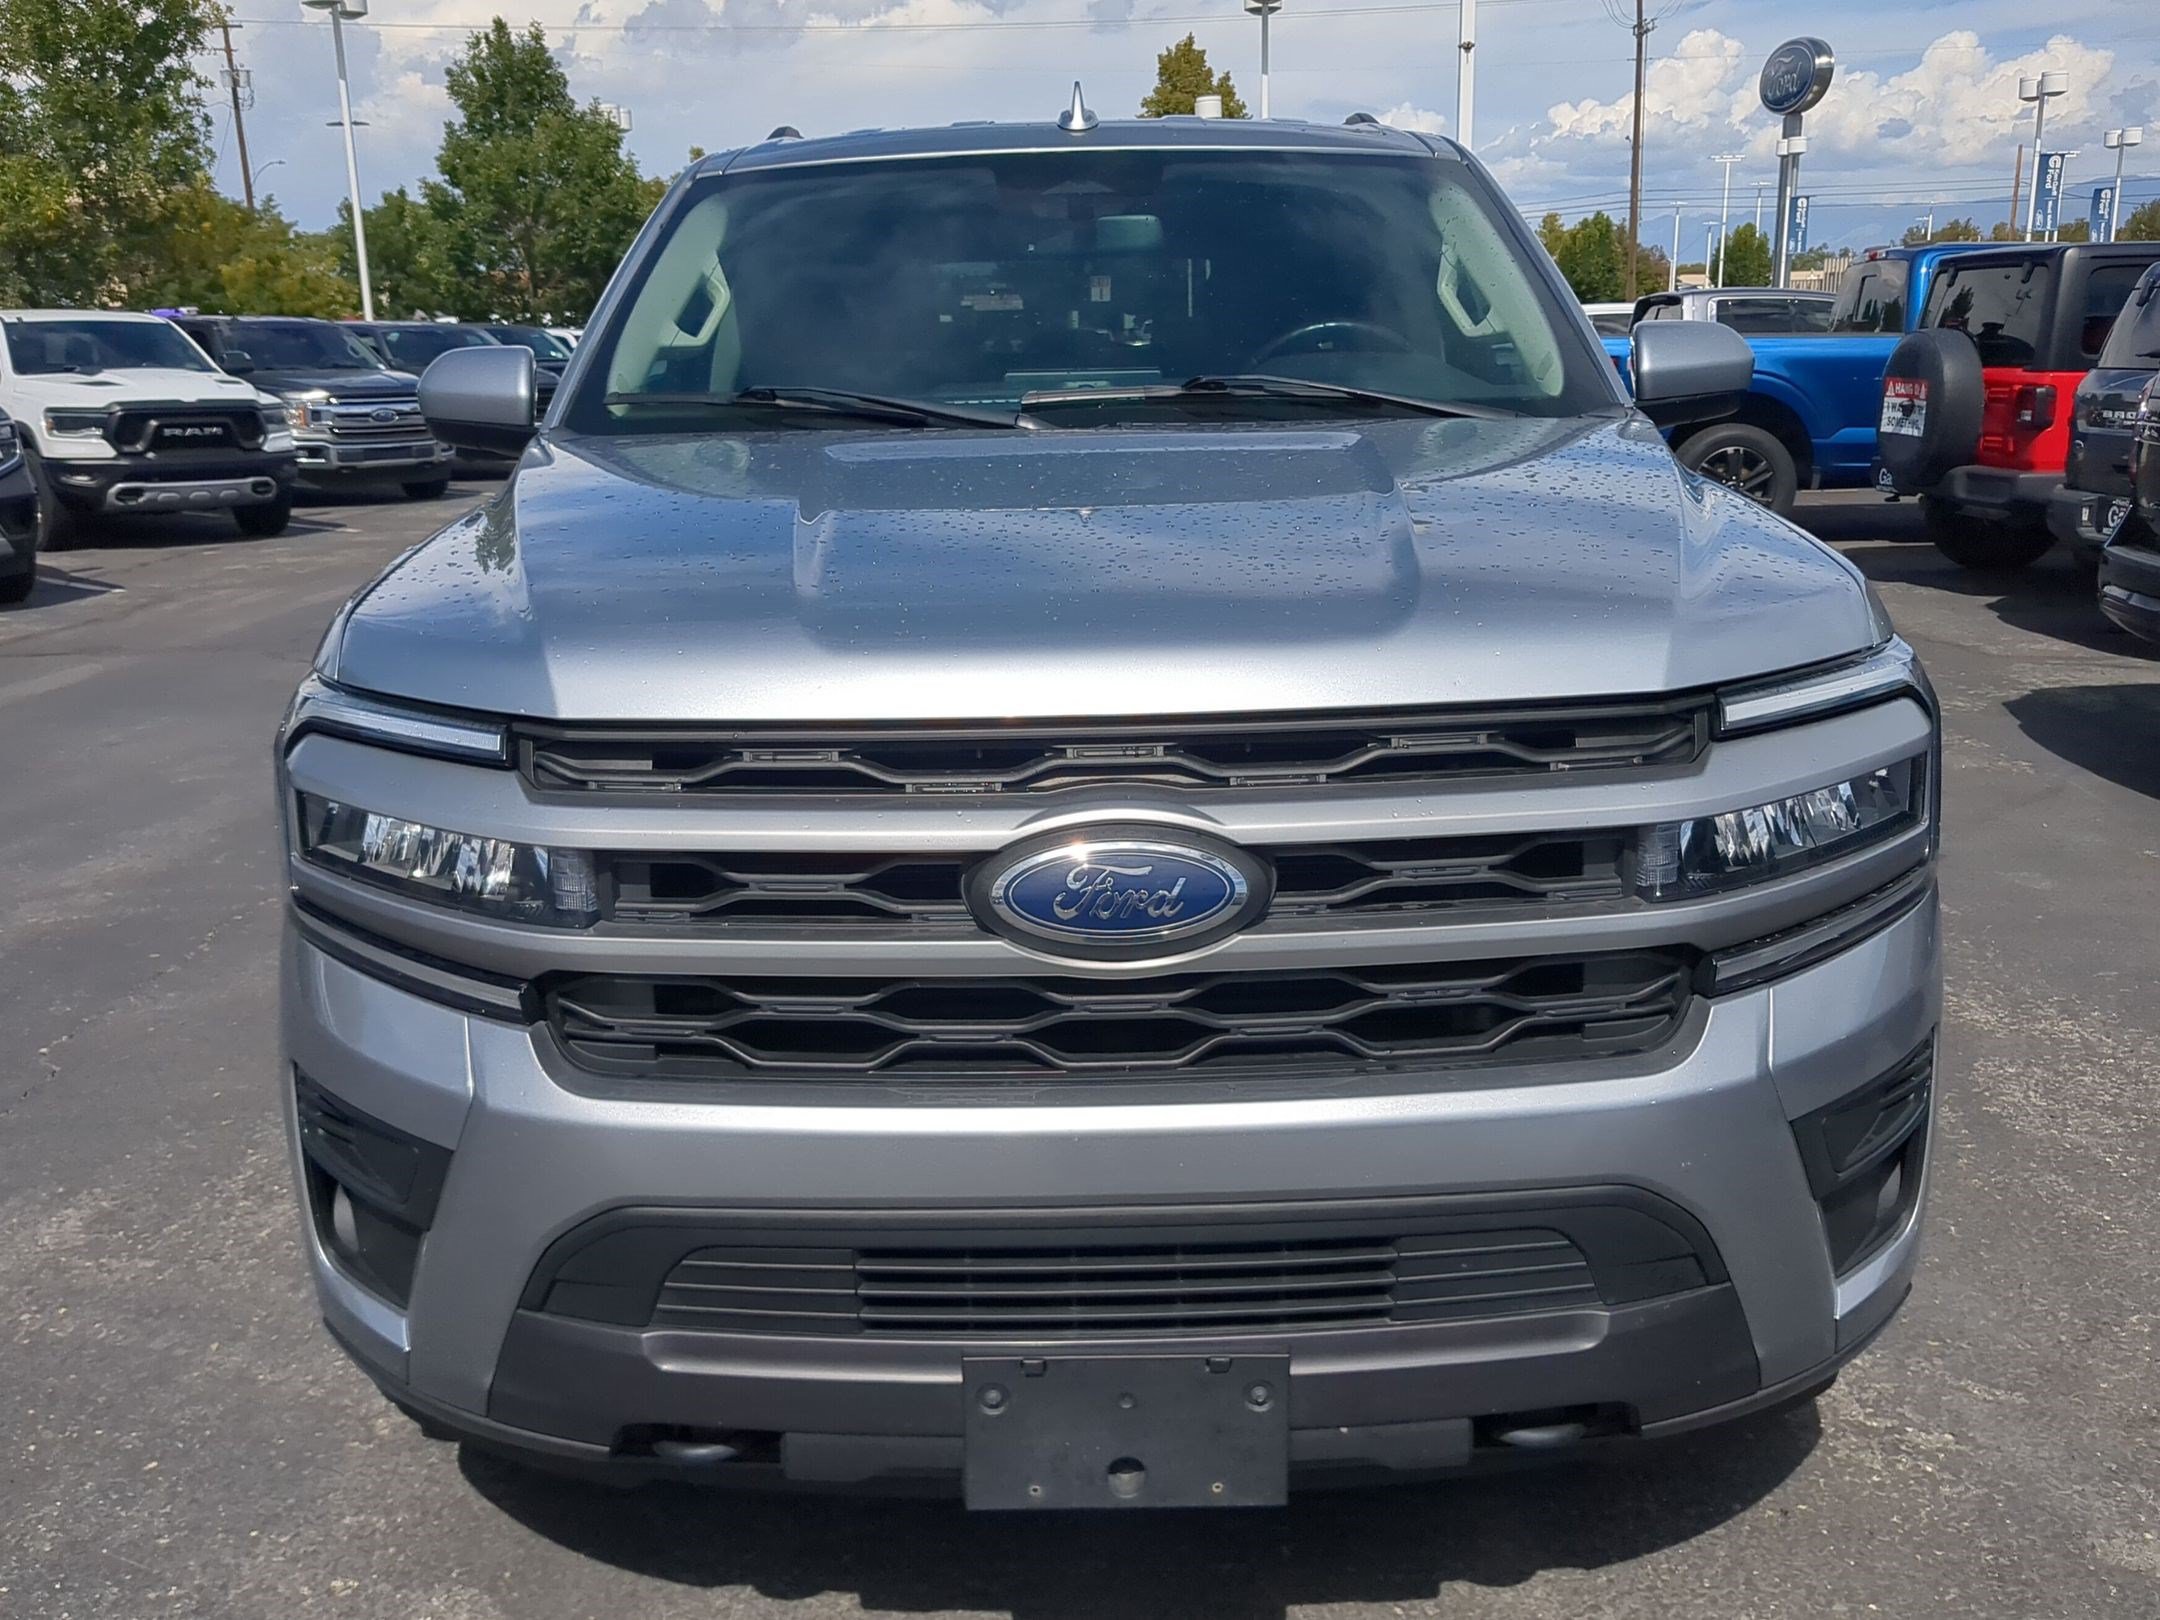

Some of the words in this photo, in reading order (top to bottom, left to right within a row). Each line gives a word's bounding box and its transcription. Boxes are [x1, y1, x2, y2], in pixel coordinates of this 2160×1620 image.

[1766, 55, 1802, 97] Ford
[2045, 169, 2054, 189] Ford
[163, 426, 223, 437] RAM
[1052, 863, 1186, 921] Ford
